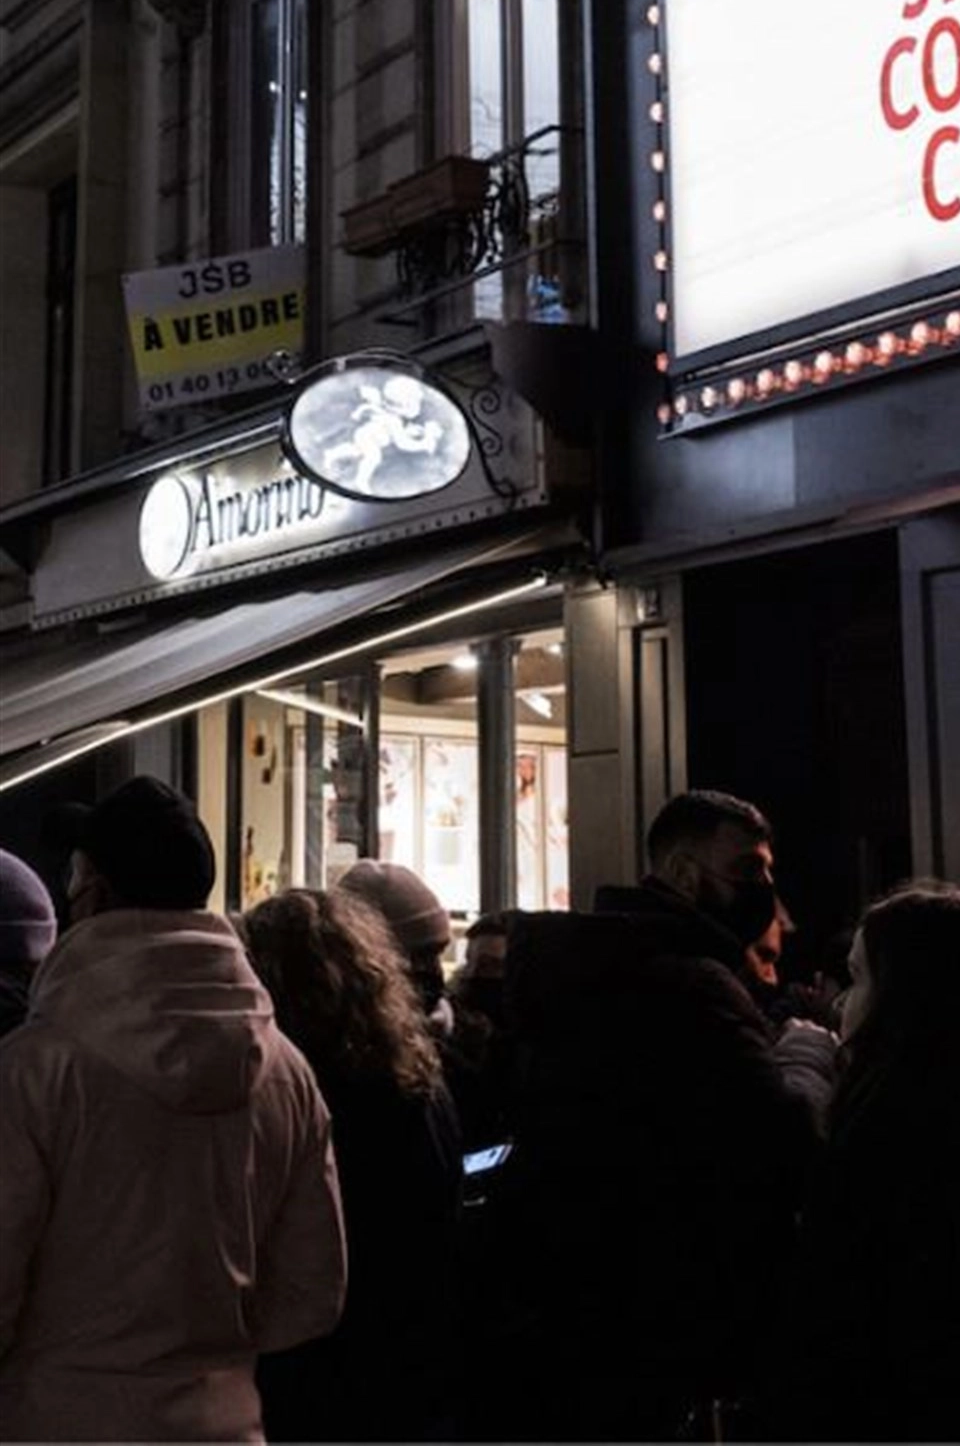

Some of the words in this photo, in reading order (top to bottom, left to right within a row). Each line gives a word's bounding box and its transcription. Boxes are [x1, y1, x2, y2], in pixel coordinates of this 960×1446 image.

[178, 259, 252, 299] JSB
[143, 317, 164, 352] À
[172, 292, 300, 345] VENDRE
[149, 381, 174, 402] 01
[181, 374, 210, 395] 40
[190, 472, 326, 554] Amorino
